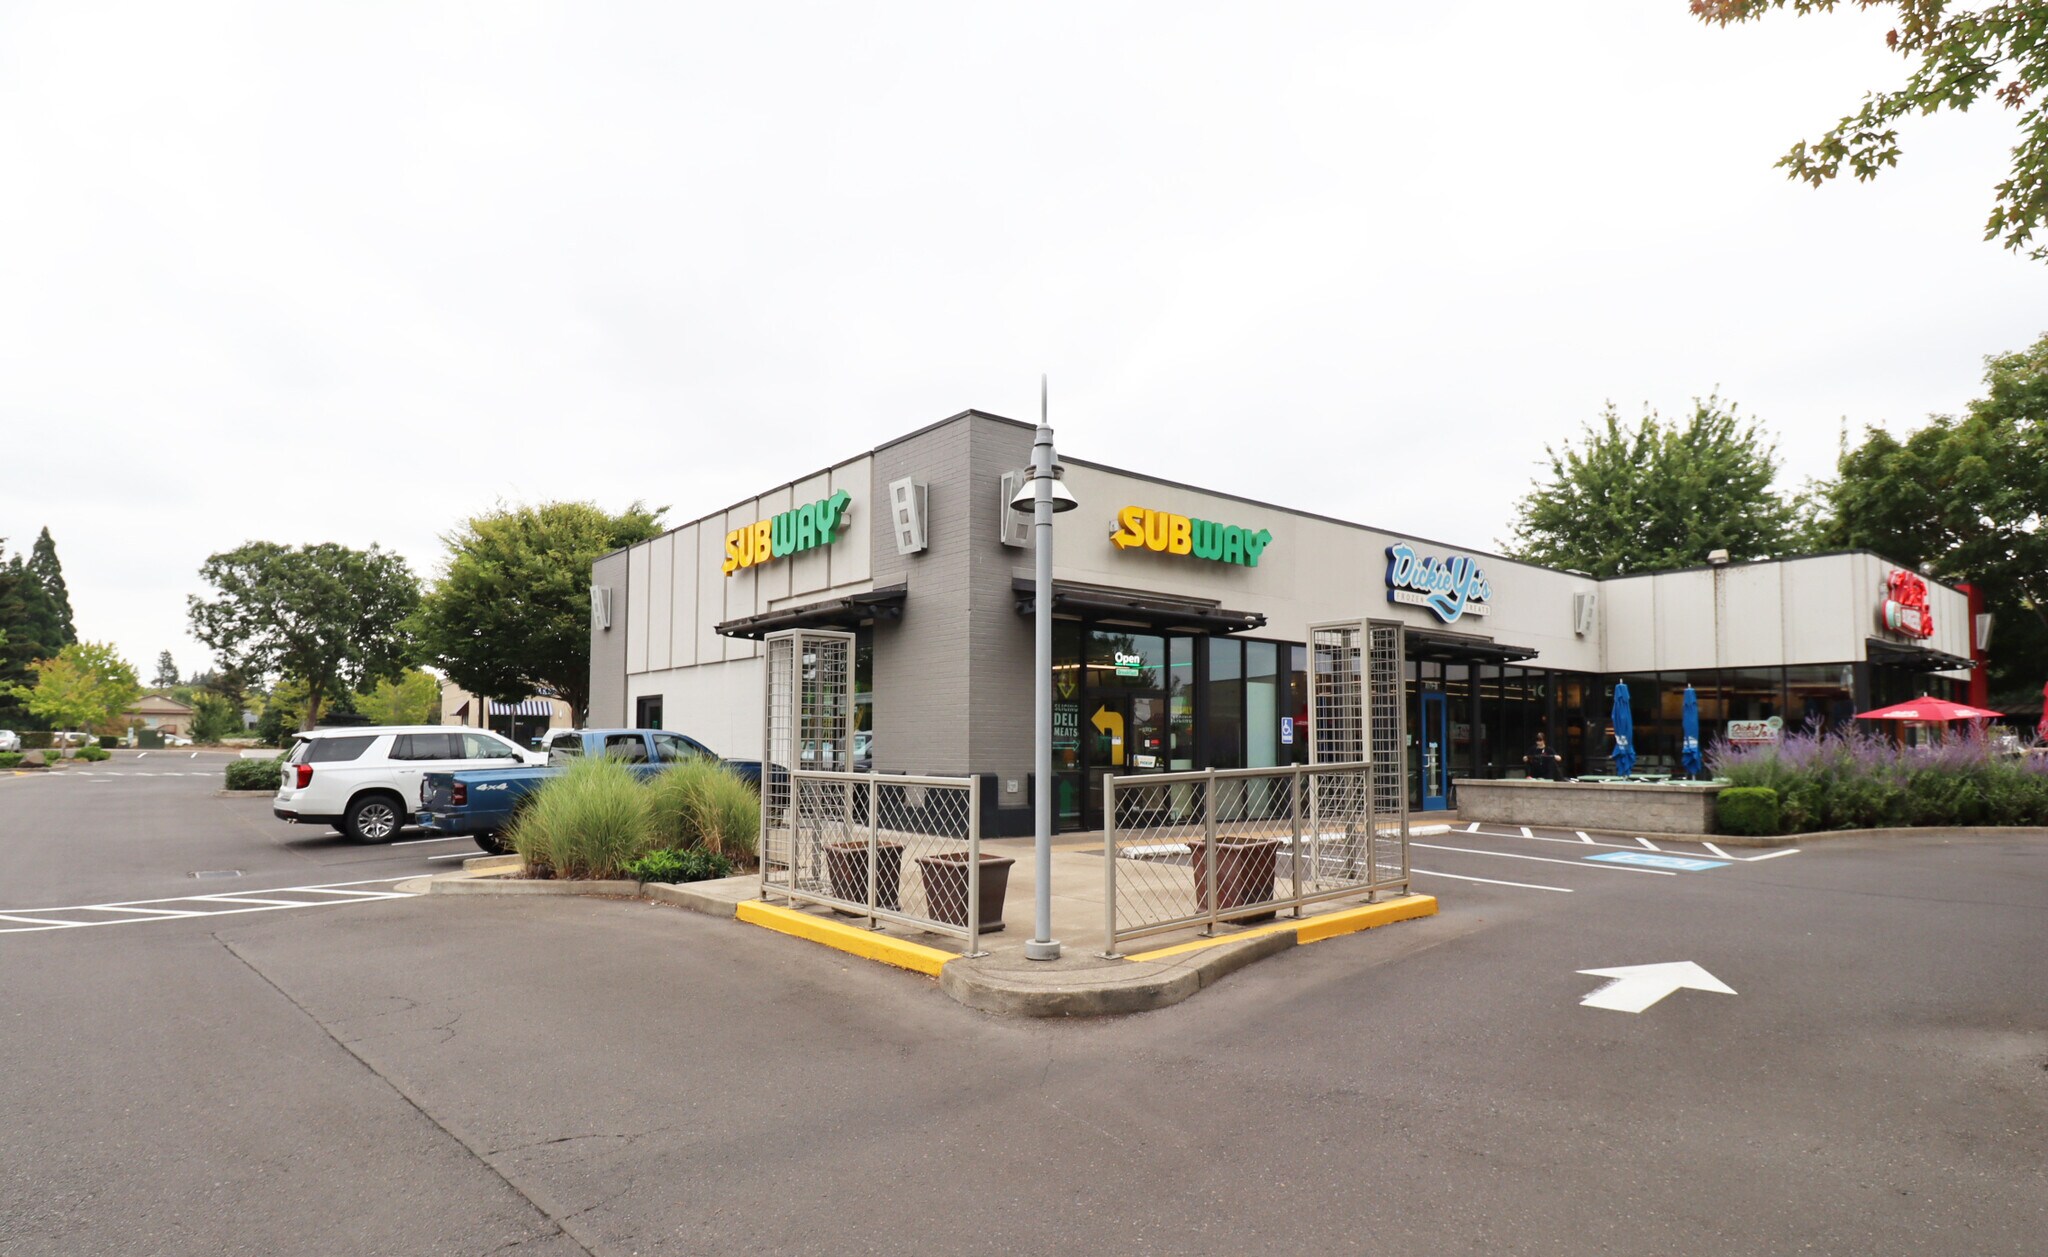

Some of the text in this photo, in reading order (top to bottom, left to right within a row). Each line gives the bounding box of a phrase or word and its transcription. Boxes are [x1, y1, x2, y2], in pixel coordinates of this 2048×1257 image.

[721, 488, 852, 576] SUBWAY
[1110, 505, 1273, 567] SUBWAY
[1391, 543, 1453, 592] Dickie
[1397, 591, 1490, 614] FROZEN TREATS
[1114, 651, 1140, 665] Open
[1053, 712, 1079, 727] DELI
[1053, 727, 1079, 737] MEATS
[475, 782, 509, 792] 4x4
